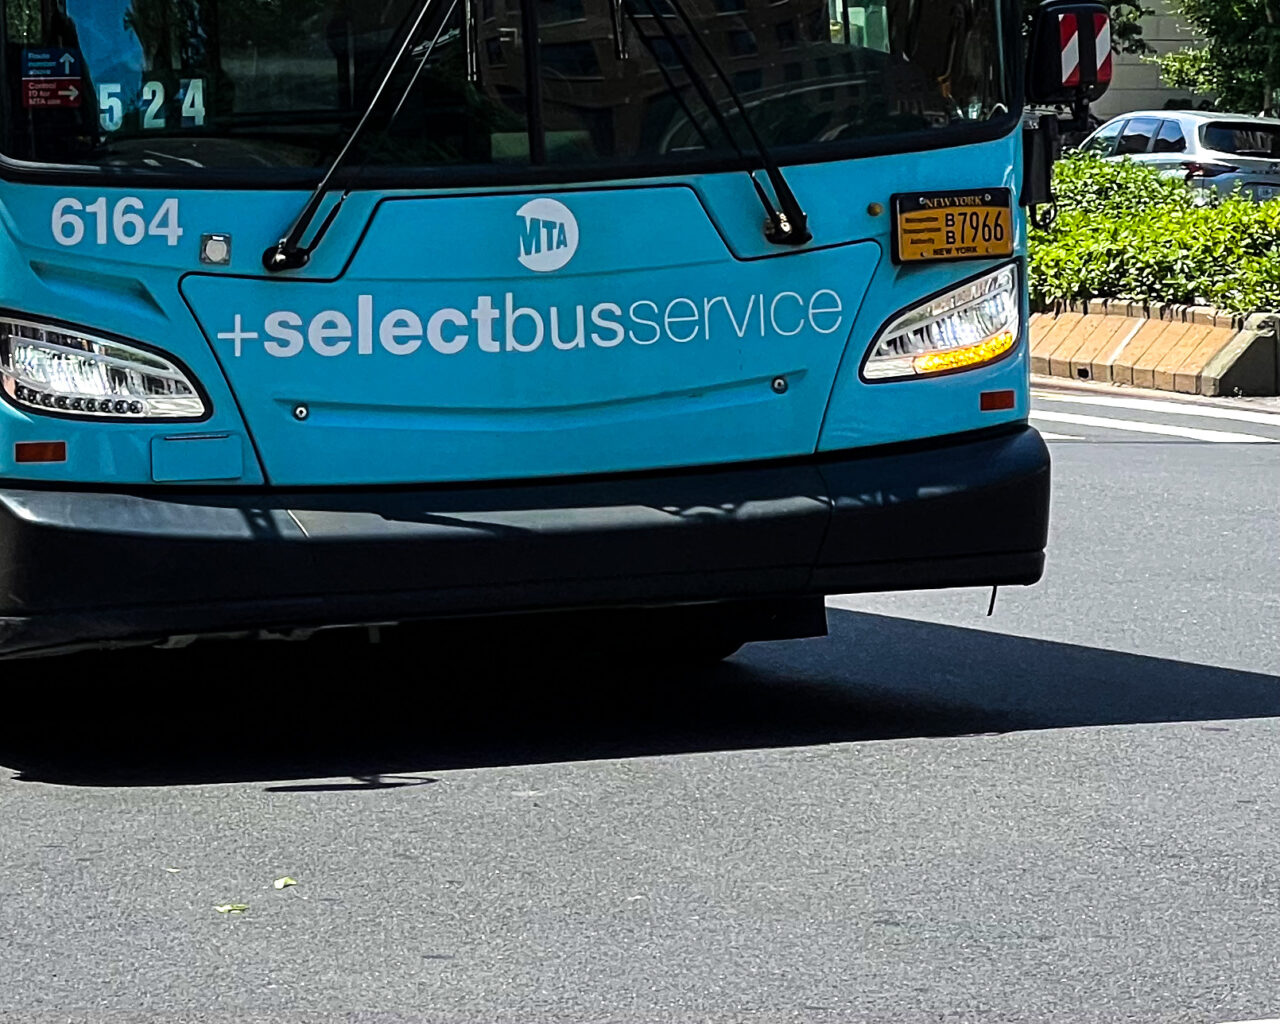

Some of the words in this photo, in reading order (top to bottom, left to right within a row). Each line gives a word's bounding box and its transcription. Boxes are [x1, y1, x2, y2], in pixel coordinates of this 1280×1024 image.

[925, 198, 954, 209] NEW
[954, 195, 983, 207] YORK
[51, 196, 184, 246] 6164
[518, 216, 569, 258] MTA
[933, 247, 953, 256] NEW
[955, 245, 978, 255] YORK
